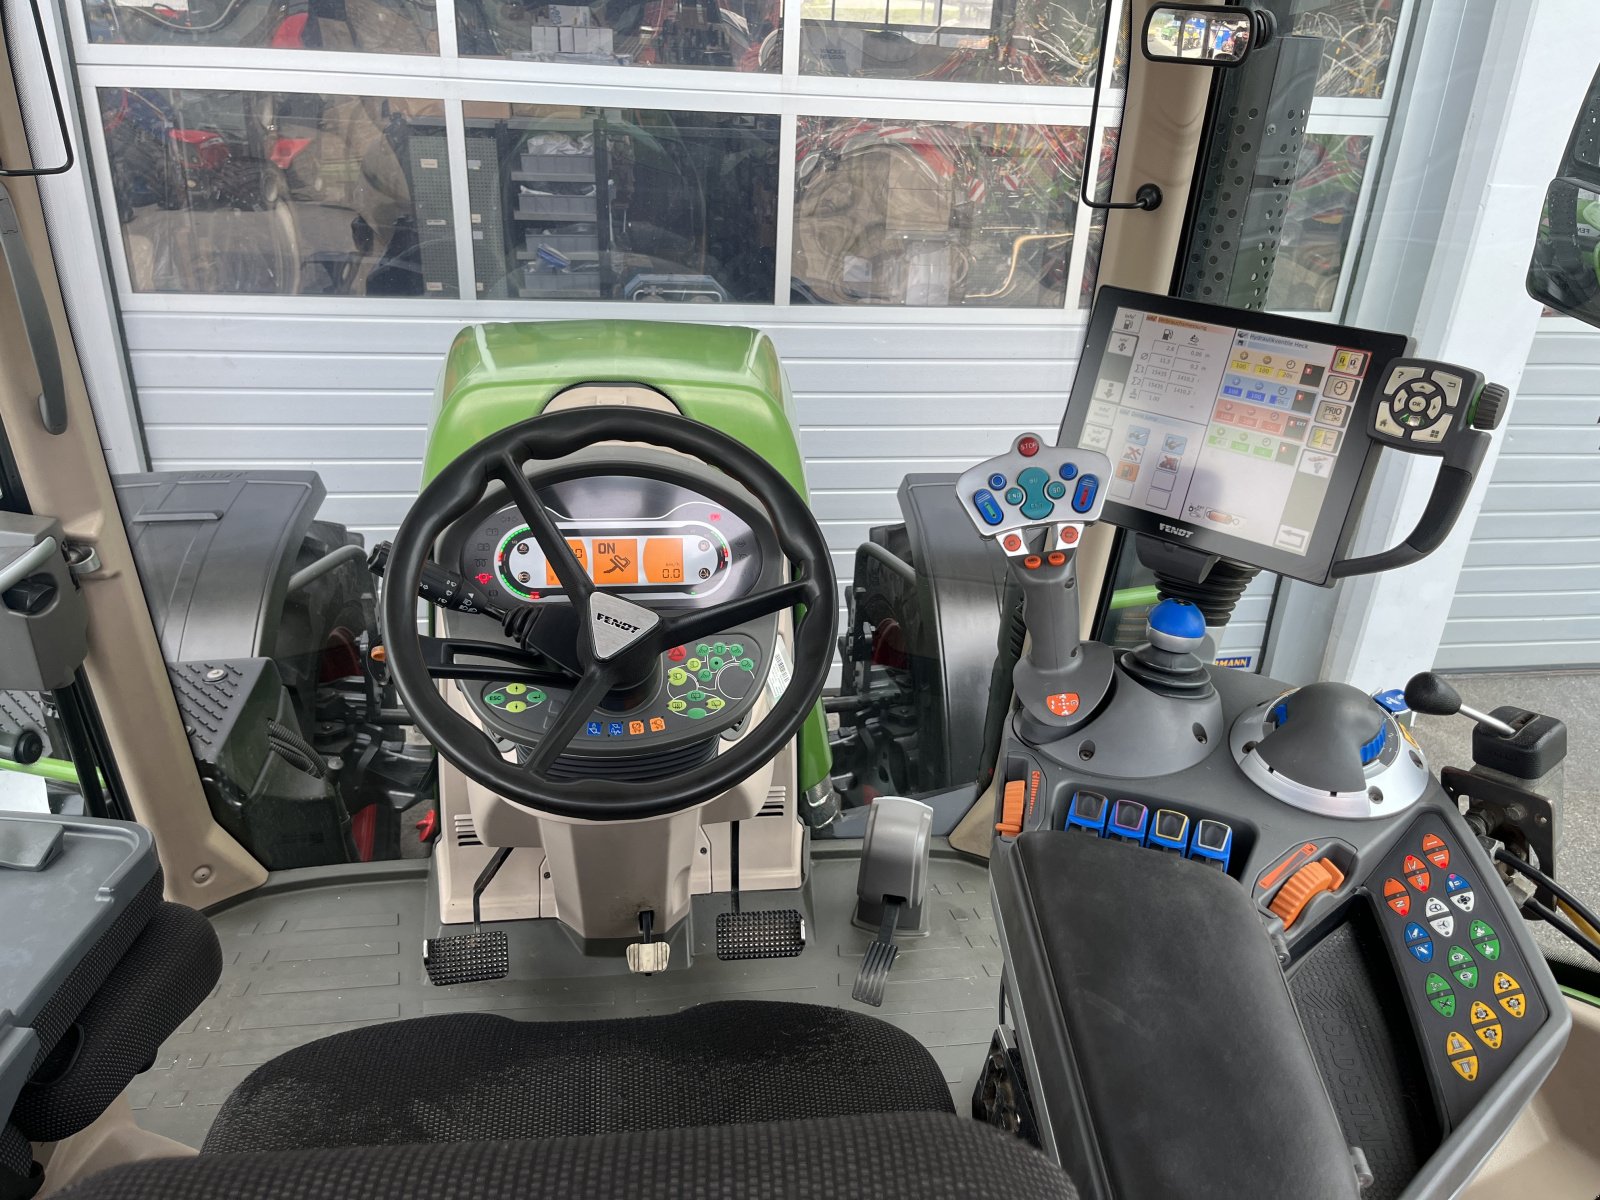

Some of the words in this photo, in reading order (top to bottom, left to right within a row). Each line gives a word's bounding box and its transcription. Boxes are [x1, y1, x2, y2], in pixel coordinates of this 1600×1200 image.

[1325, 406, 1343, 416] PRIO
[1020, 442, 1038, 450] STOP
[1159, 522, 1195, 538] FENDT
[597, 543, 616, 555] ON
[662, 568, 681, 579] 0.0
[596, 612, 641, 634] FENDT
